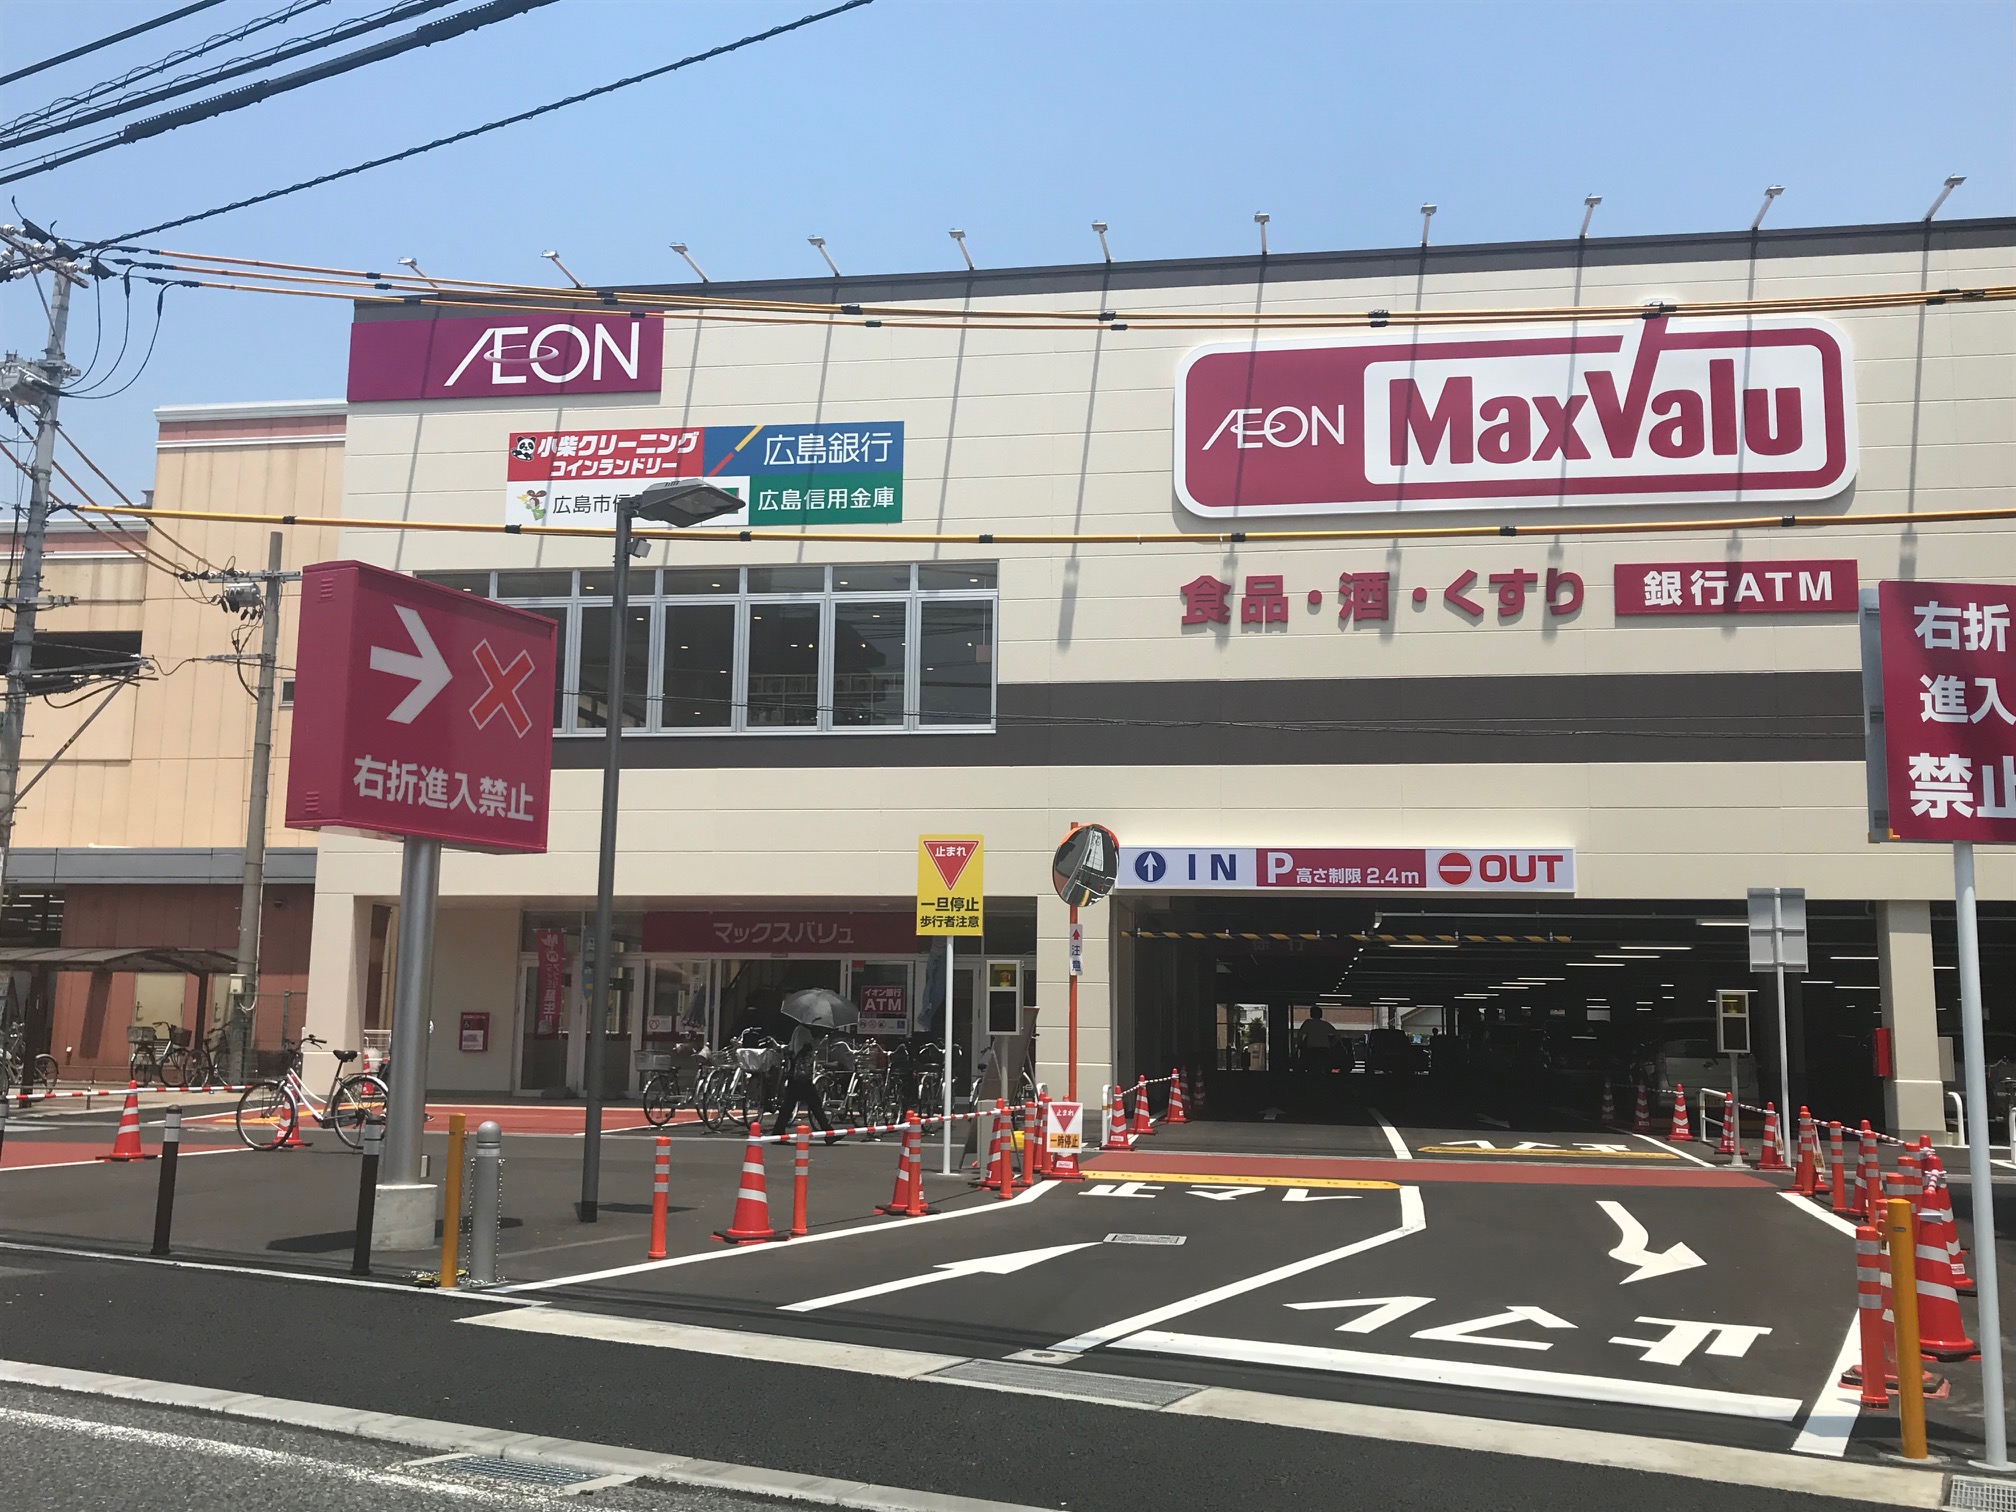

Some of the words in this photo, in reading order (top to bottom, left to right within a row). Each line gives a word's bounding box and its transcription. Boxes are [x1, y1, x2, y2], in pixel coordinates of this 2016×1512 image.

[1389, 317, 1802, 467] MaxValu
[537, 431, 698, 457] 小柴クリーニング
[762, 432, 893, 467] 広島銀行
[550, 459, 679, 478] コインランドリー
[757, 485, 896, 512] 広島信用金庫
[1180, 568, 1585, 625] 食品・酒・くすり
[1643, 568, 1834, 607] 銀行ATM
[1913, 600, 2011, 653] 右折
[1919, 674, 2016, 725] 進入
[353, 754, 534, 822] 右折進入禁止
[935, 846, 967, 857] 止まれ
[1188, 853, 1237, 881] IN
[1267, 852, 1294, 884] P
[1296, 867, 1361, 885] 高さ制限
[1366, 866, 1420, 885] 2.4m
[1479, 854, 1564, 883] OUT
[920, 897, 980, 912] 一旦停止
[713, 921, 855, 944] マックスバリュ
[920, 915, 980, 928] 歩行者注意
[1071, 944, 1082, 972] 注意
[864, 988, 902, 997] イオン銀行
[864, 998, 902, 1011] ATM
[1051, 1135, 1077, 1148] 一時停止
